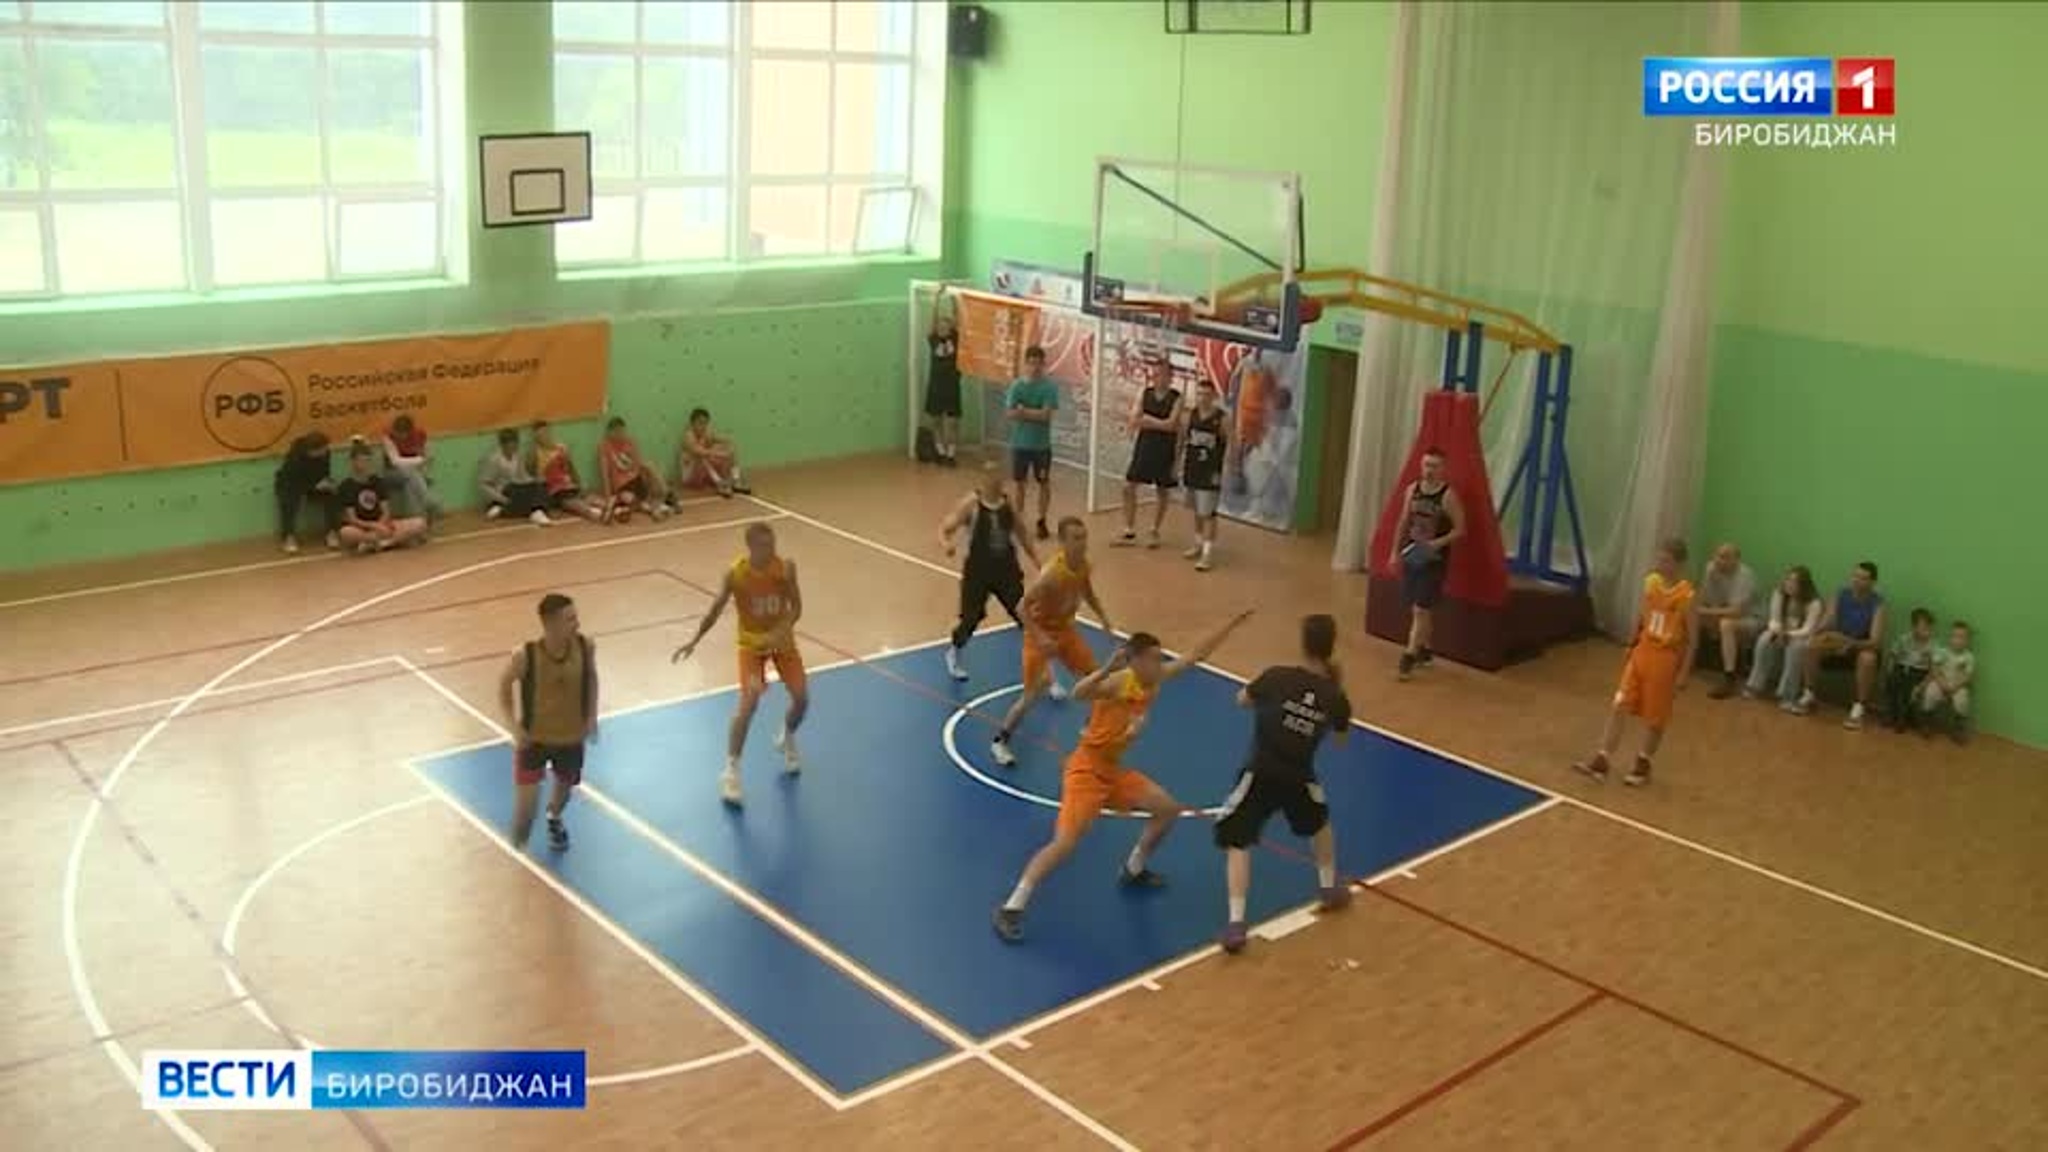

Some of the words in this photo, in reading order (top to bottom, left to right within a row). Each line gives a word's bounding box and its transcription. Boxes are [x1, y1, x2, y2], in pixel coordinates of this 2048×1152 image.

[308, 368, 428, 392] Российская
[431, 357, 541, 380] Федерация
[214, 389, 286, 419] РФБ
[308, 394, 428, 420] Баскетбола
